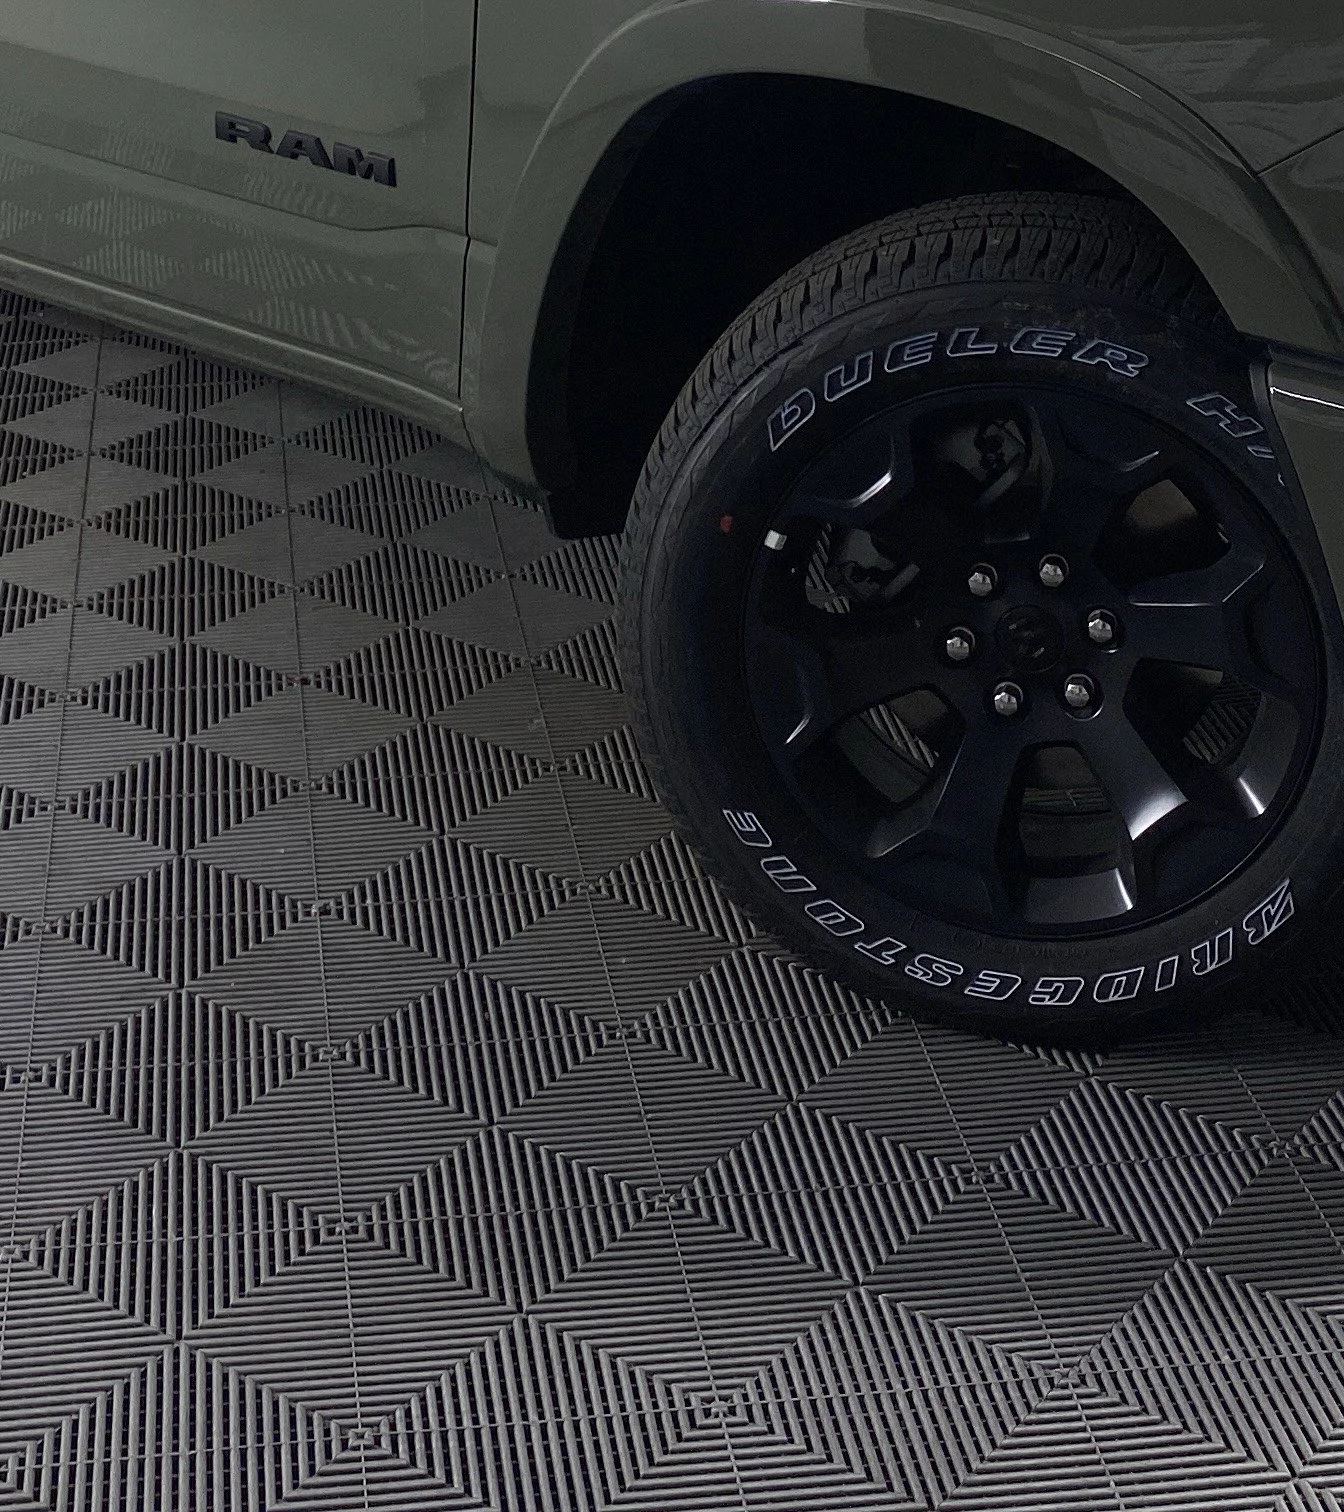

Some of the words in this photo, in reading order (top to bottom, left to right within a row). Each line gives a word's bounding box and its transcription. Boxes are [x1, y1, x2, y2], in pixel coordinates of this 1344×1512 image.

[214, 110, 398, 188] RAM
[766, 327, 1150, 452] DUELER
[721, 807, 1296, 1007] BRIDGESTONE
